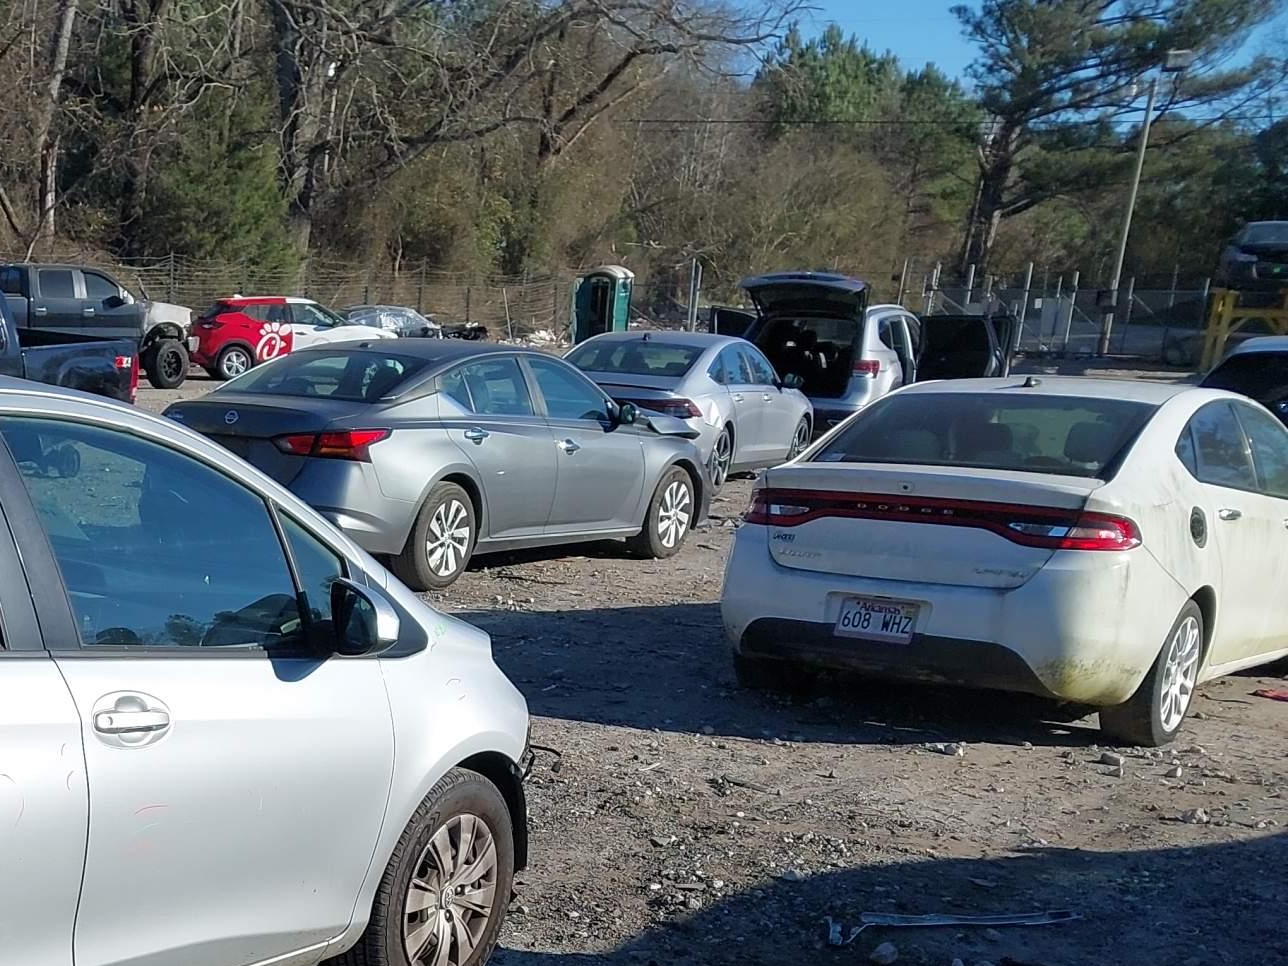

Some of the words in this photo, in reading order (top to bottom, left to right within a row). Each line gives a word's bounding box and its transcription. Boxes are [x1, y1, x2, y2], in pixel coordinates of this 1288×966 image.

[857, 502, 953, 515] DODGE
[841, 610, 872, 630] 608
[880, 613, 912, 634] WHZ
